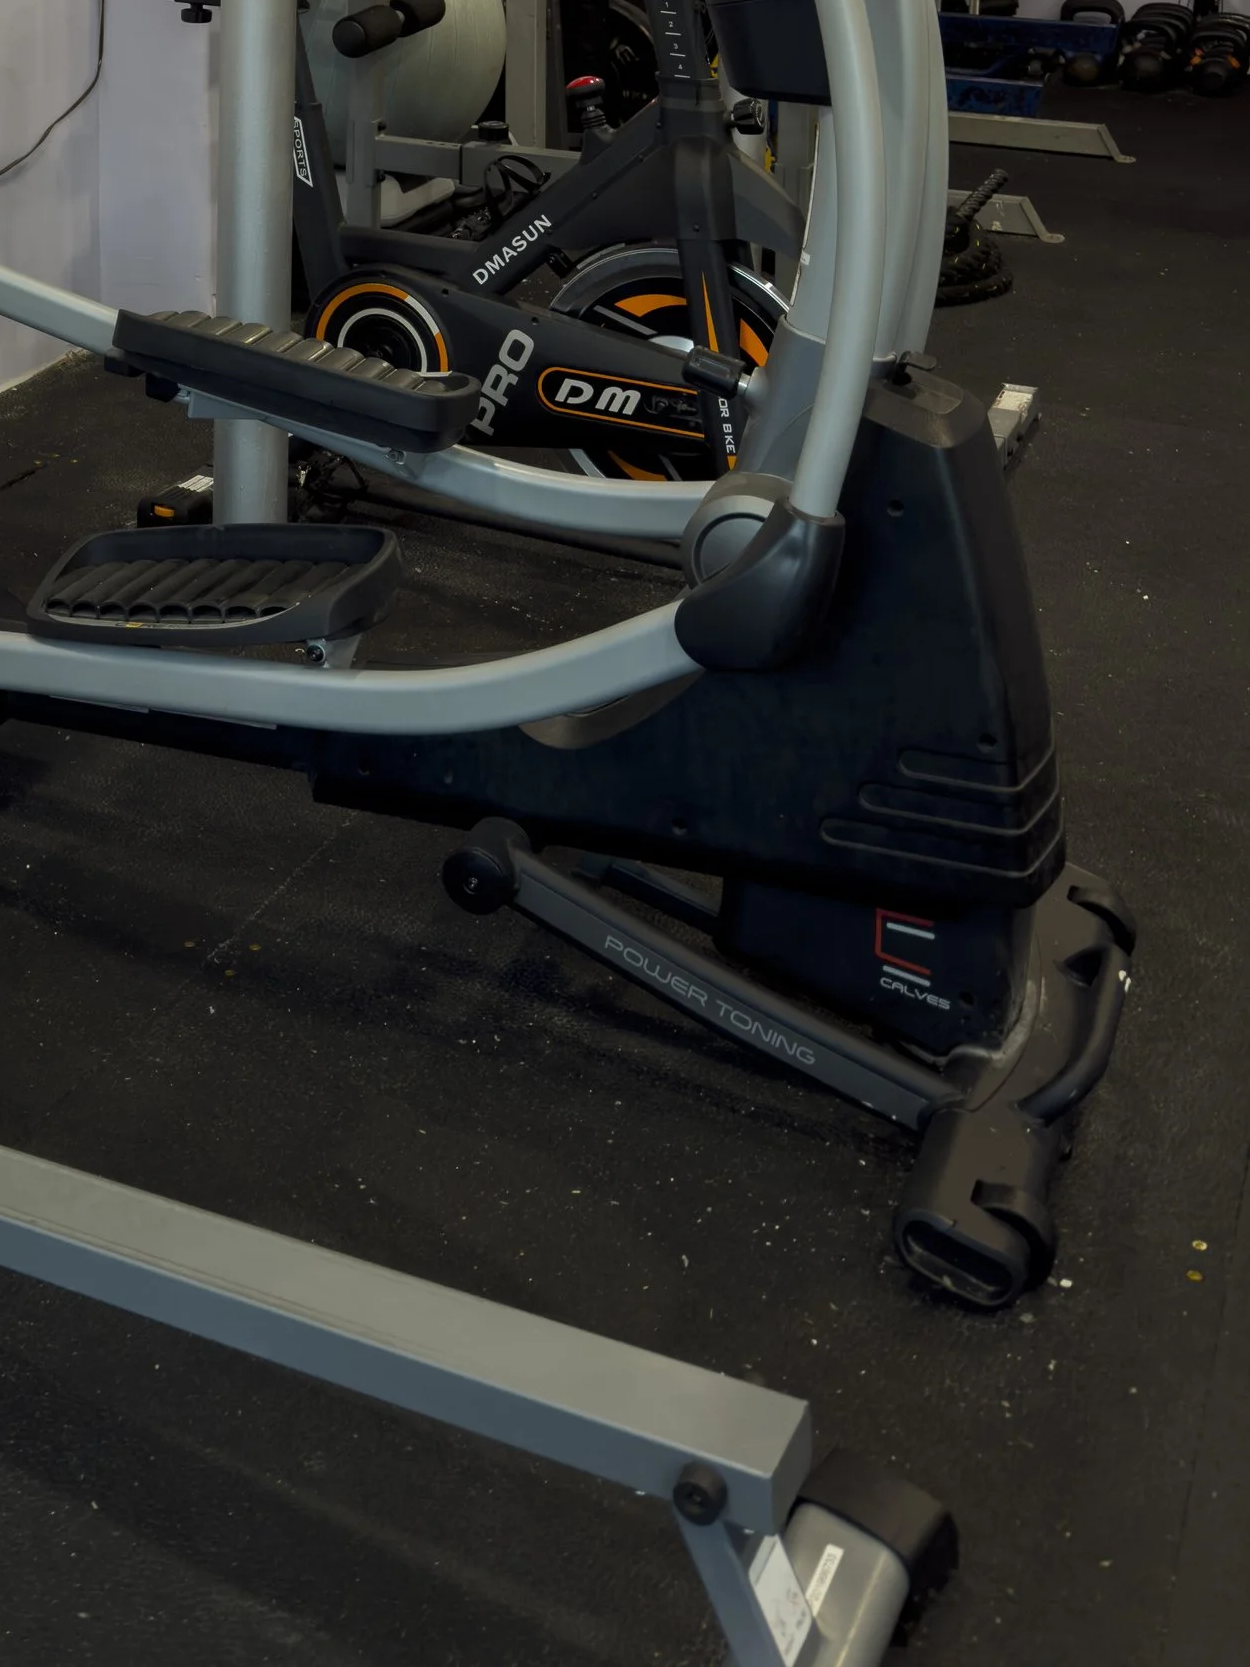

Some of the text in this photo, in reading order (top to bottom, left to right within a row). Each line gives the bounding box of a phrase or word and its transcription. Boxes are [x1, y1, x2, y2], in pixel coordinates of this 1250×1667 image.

[472, 214, 552, 285] DMASUN
[471, 328, 535, 437] PRO
[554, 378, 642, 417] DM
[603, 933, 816, 1069] POWER TONING
[880, 975, 951, 1011] CALVES
